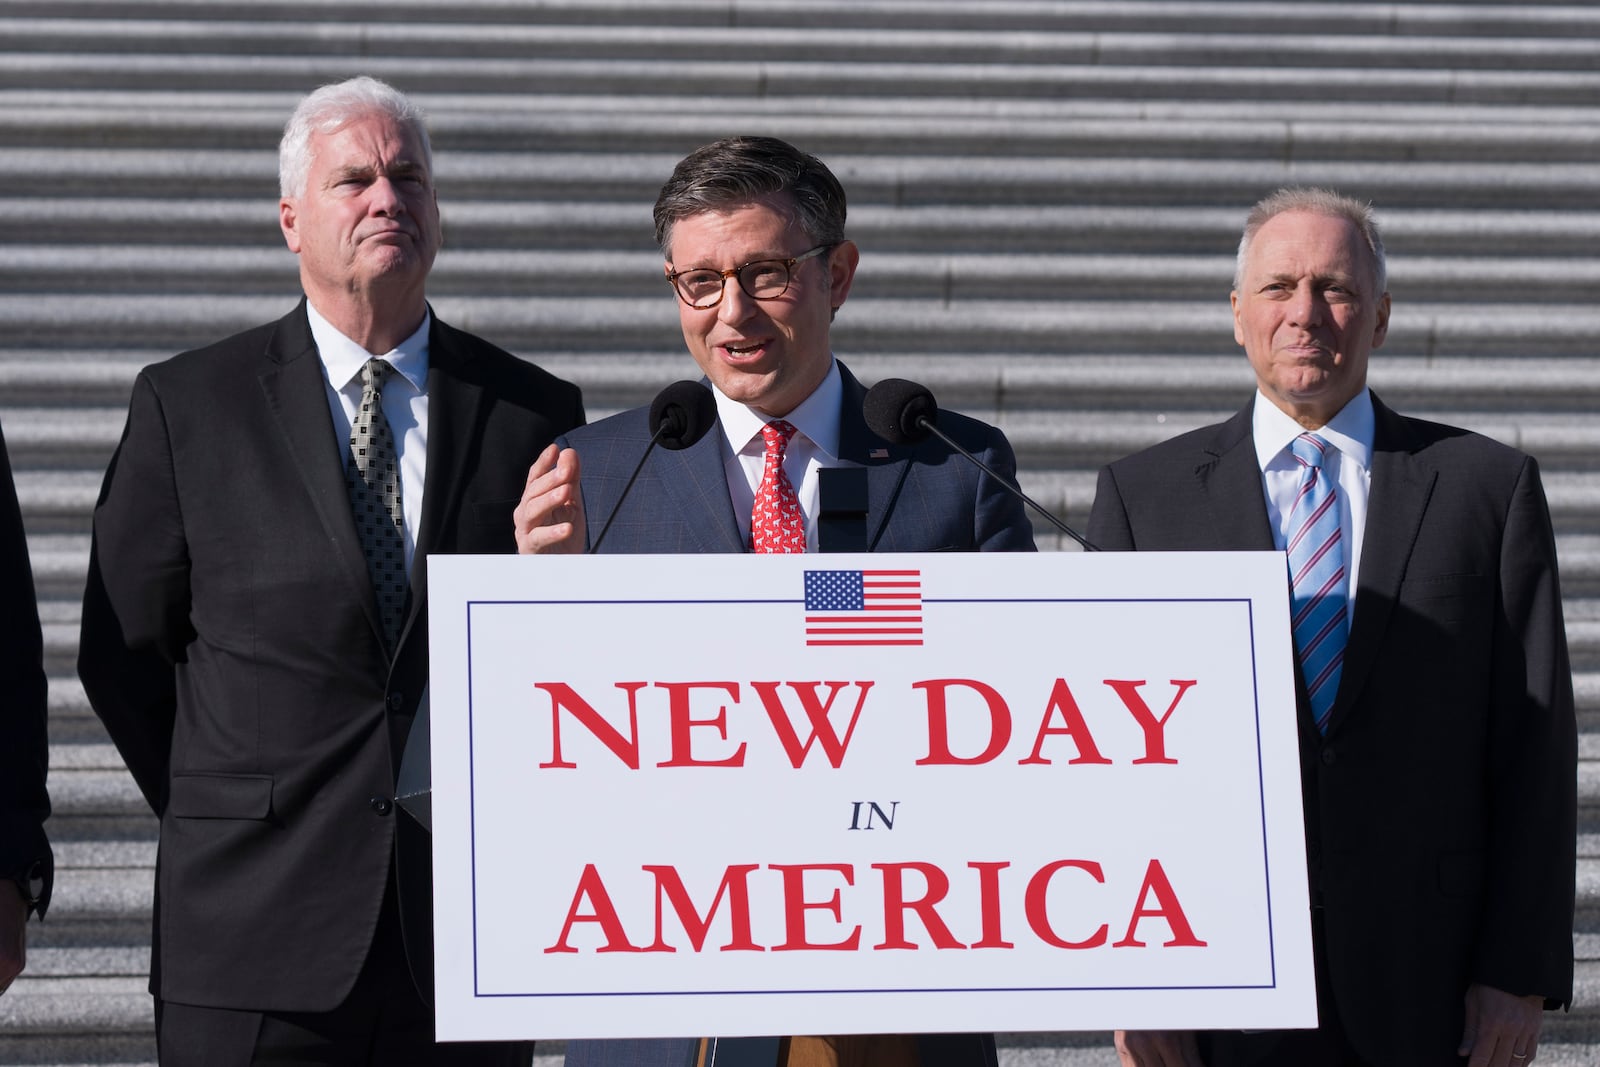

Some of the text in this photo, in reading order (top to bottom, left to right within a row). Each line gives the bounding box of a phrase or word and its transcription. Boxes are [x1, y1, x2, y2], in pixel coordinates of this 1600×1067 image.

[534, 677, 1198, 770] NEW DAY
[848, 801, 900, 831] IN
[543, 858, 1208, 954] AMERICA
